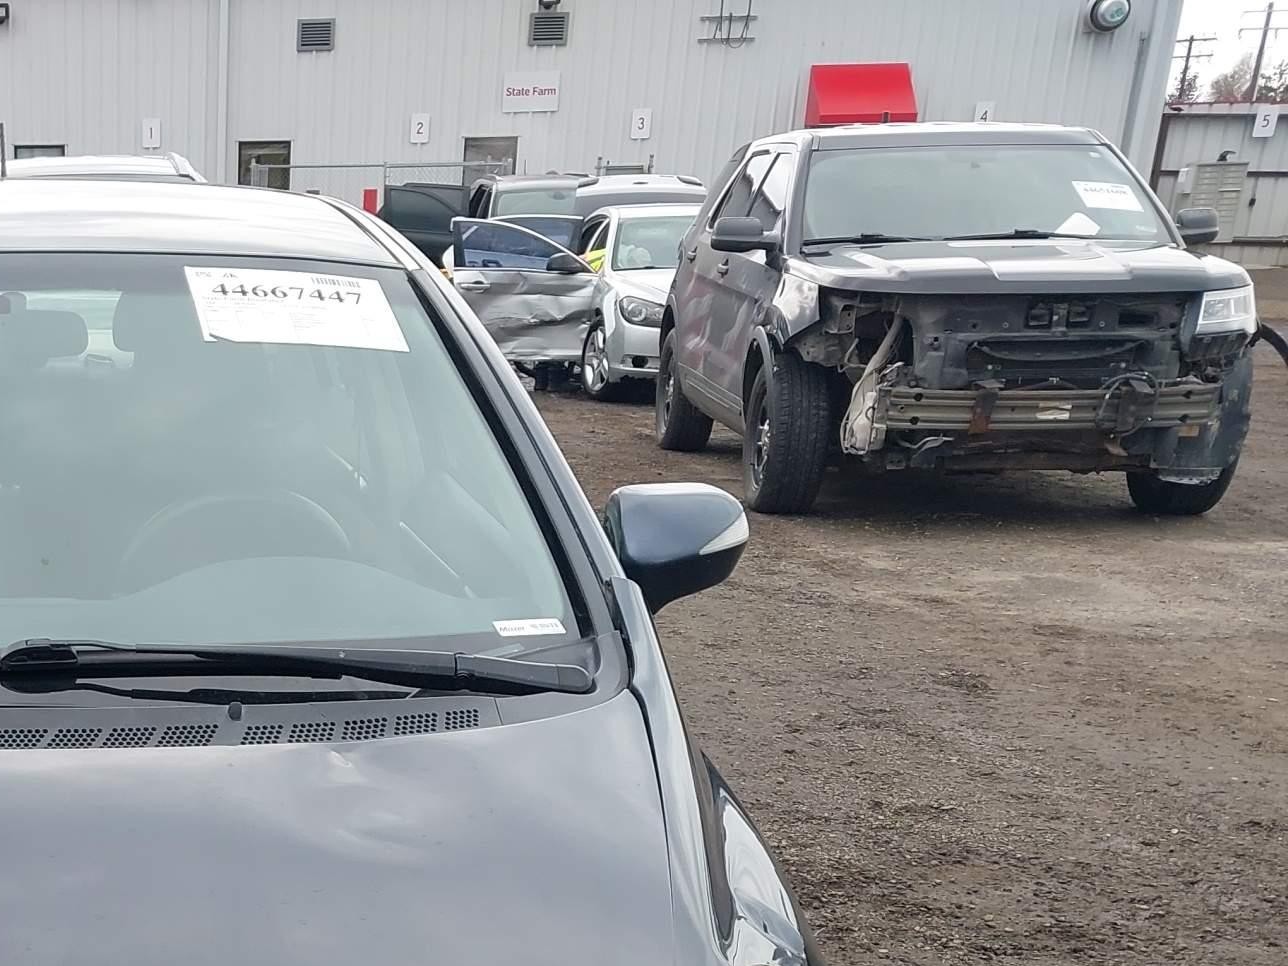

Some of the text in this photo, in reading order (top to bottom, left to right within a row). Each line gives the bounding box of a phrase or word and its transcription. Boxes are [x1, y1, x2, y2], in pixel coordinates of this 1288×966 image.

[506, 86, 556, 96] State Farm
[637, 116, 645, 130] 3
[980, 110, 988, 122] 4
[1261, 114, 1271, 128] 5
[416, 121, 424, 135] 2
[212, 282, 361, 305] 44667447
